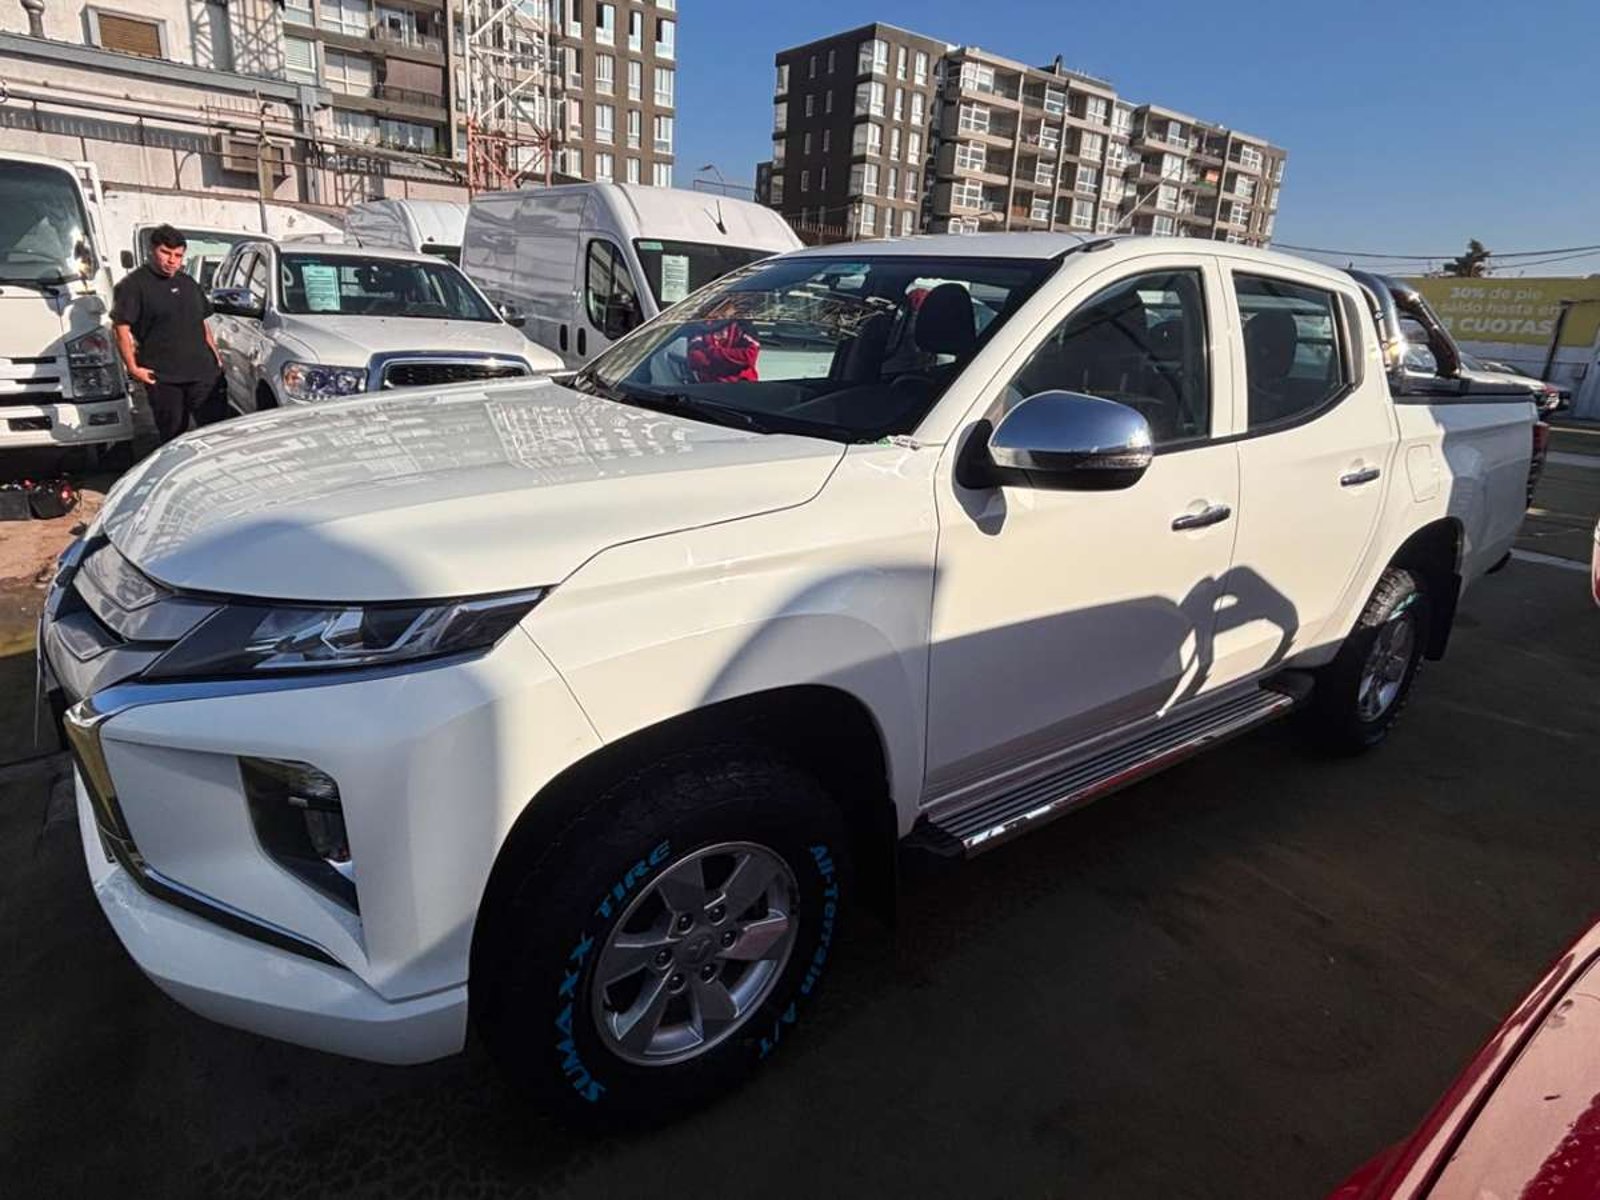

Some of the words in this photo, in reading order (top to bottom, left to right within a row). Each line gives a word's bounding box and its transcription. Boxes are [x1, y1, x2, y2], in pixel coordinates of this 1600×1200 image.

[1450, 287, 1485, 299] 30%
[1489, 287, 1510, 299] de
[1514, 287, 1542, 301] pie
[1486, 302, 1533, 315] hasta
[1459, 318, 1554, 334] CUOTAS
[555, 931, 607, 1103] SUMAXX
[595, 839, 671, 918] TIRE
